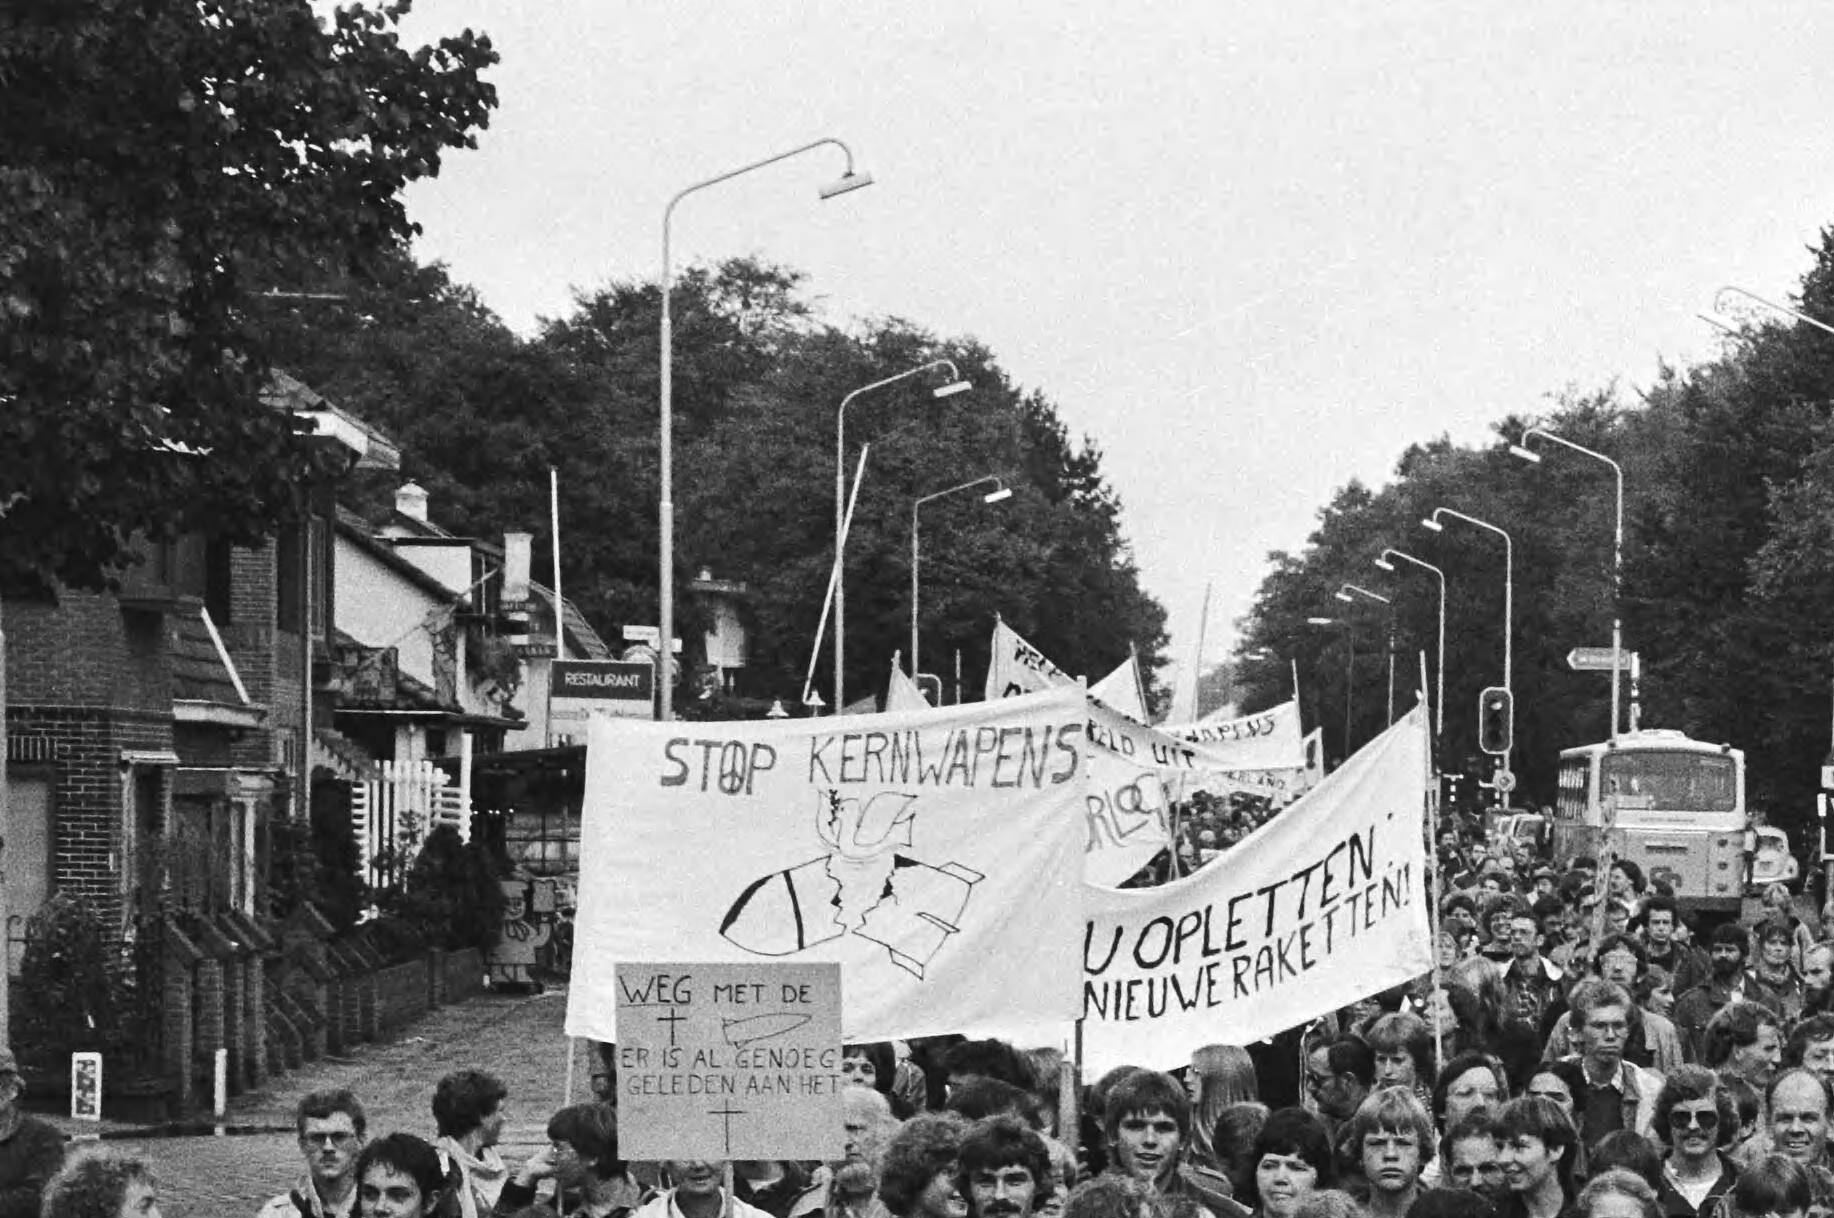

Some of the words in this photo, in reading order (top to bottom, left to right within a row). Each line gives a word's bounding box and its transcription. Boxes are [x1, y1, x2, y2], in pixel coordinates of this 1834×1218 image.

[564, 672, 641, 688] RESTAURANT
[660, 738, 778, 796] STOP
[809, 723, 1082, 789] KERNWAPENS
[1083, 962, 1222, 1021] NIEUWE
[1232, 861, 1410, 999] RAKETTEN!
[618, 974, 692, 1004] WEG
[713, 983, 766, 1004] MET
[781, 984, 813, 1004] DE
[621, 1047, 649, 1069] ER
[662, 1047, 683, 1069] IS
[693, 1048, 722, 1069] AL
[735, 1048, 836, 1069] GENOEG
[626, 1074, 736, 1096] GELEDEN
[746, 1074, 791, 1095] AAN
[800, 1074, 841, 1096] HET
